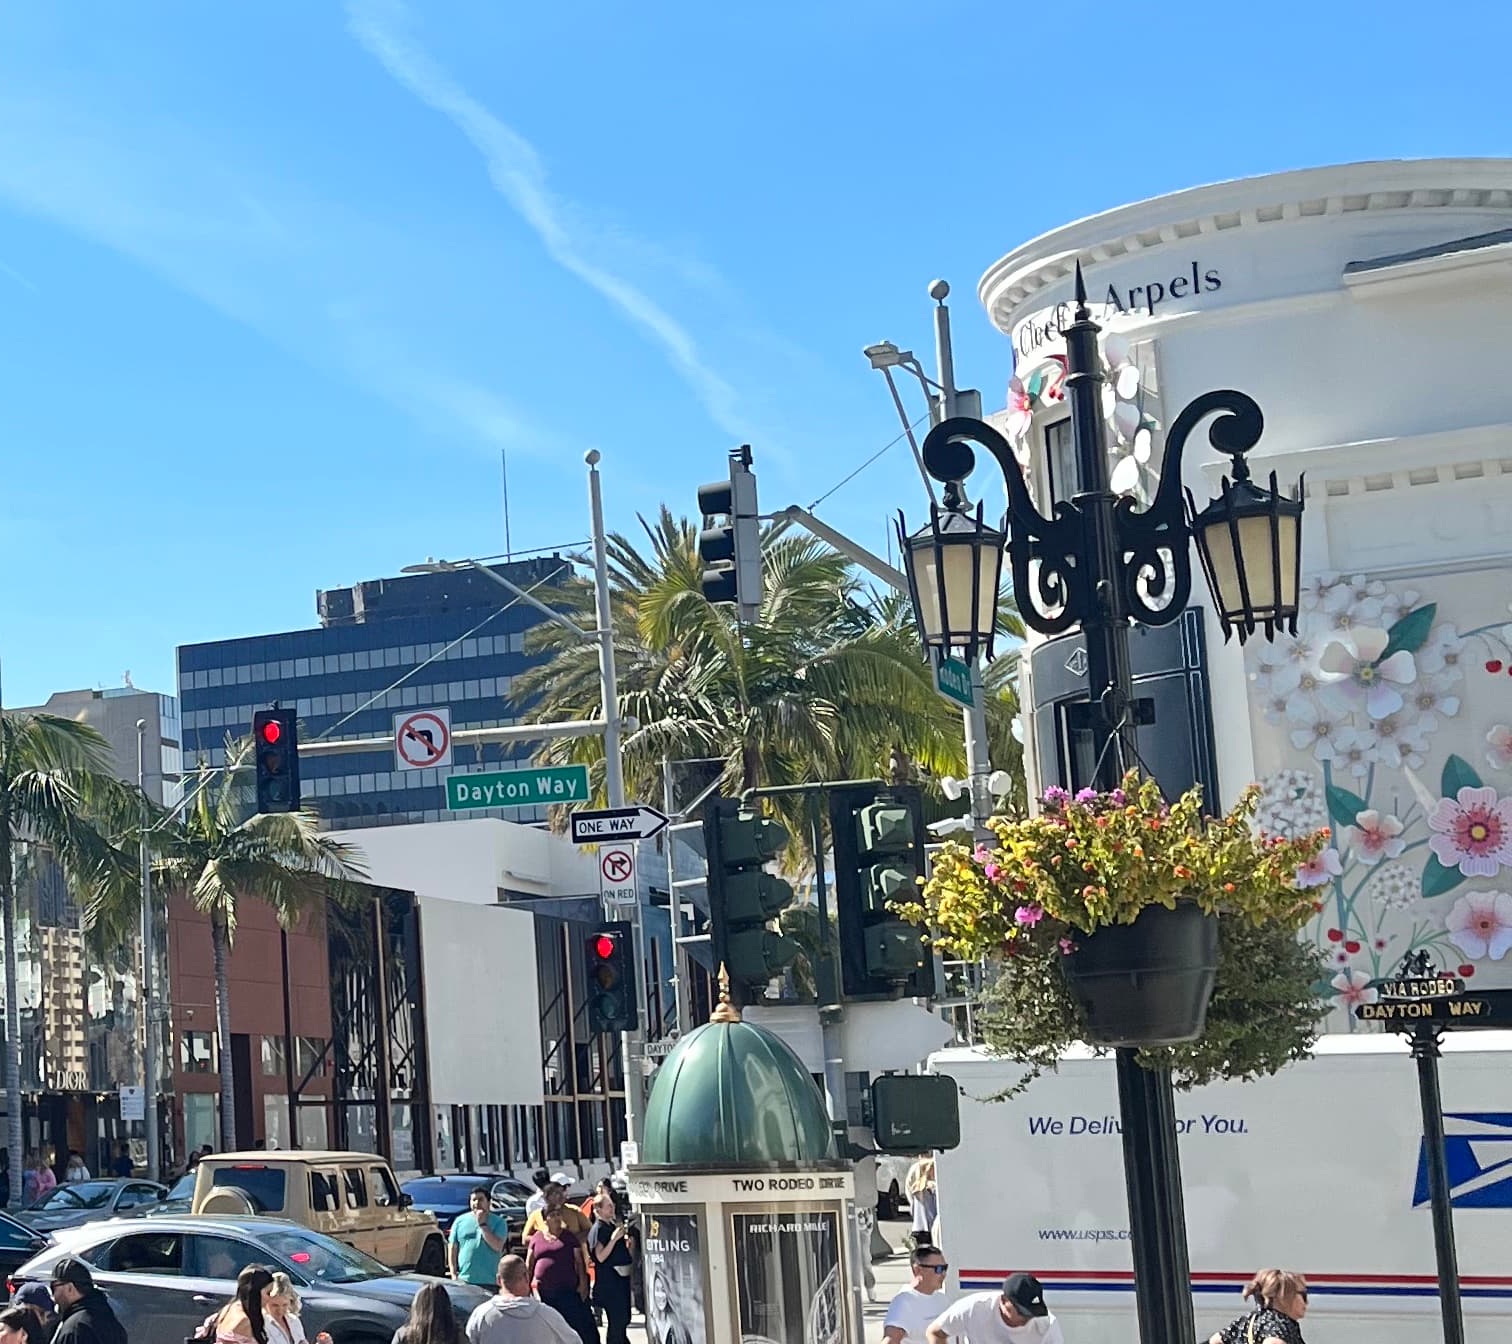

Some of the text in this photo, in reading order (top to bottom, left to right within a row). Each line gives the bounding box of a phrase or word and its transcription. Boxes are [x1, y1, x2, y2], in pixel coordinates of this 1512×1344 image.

[1104, 261, 1222, 319] Arpels
[456, 776, 578, 804] Dayton Way
[578, 817, 636, 834] ONE WAY
[603, 888, 635, 900] ON RED
[1384, 979, 1456, 997] VIA RODEO
[1362, 1001, 1483, 1019] DAYTON WAY
[647, 1044, 676, 1055] DAYTO
[56, 1070, 88, 1090] DIOR
[1028, 1114, 1249, 1136] We Deliv or You.
[654, 1181, 688, 1193] DRIVE
[732, 1176, 845, 1192] TWO RODEO DRIVE
[749, 1221, 827, 1234] RICHARD MILLE
